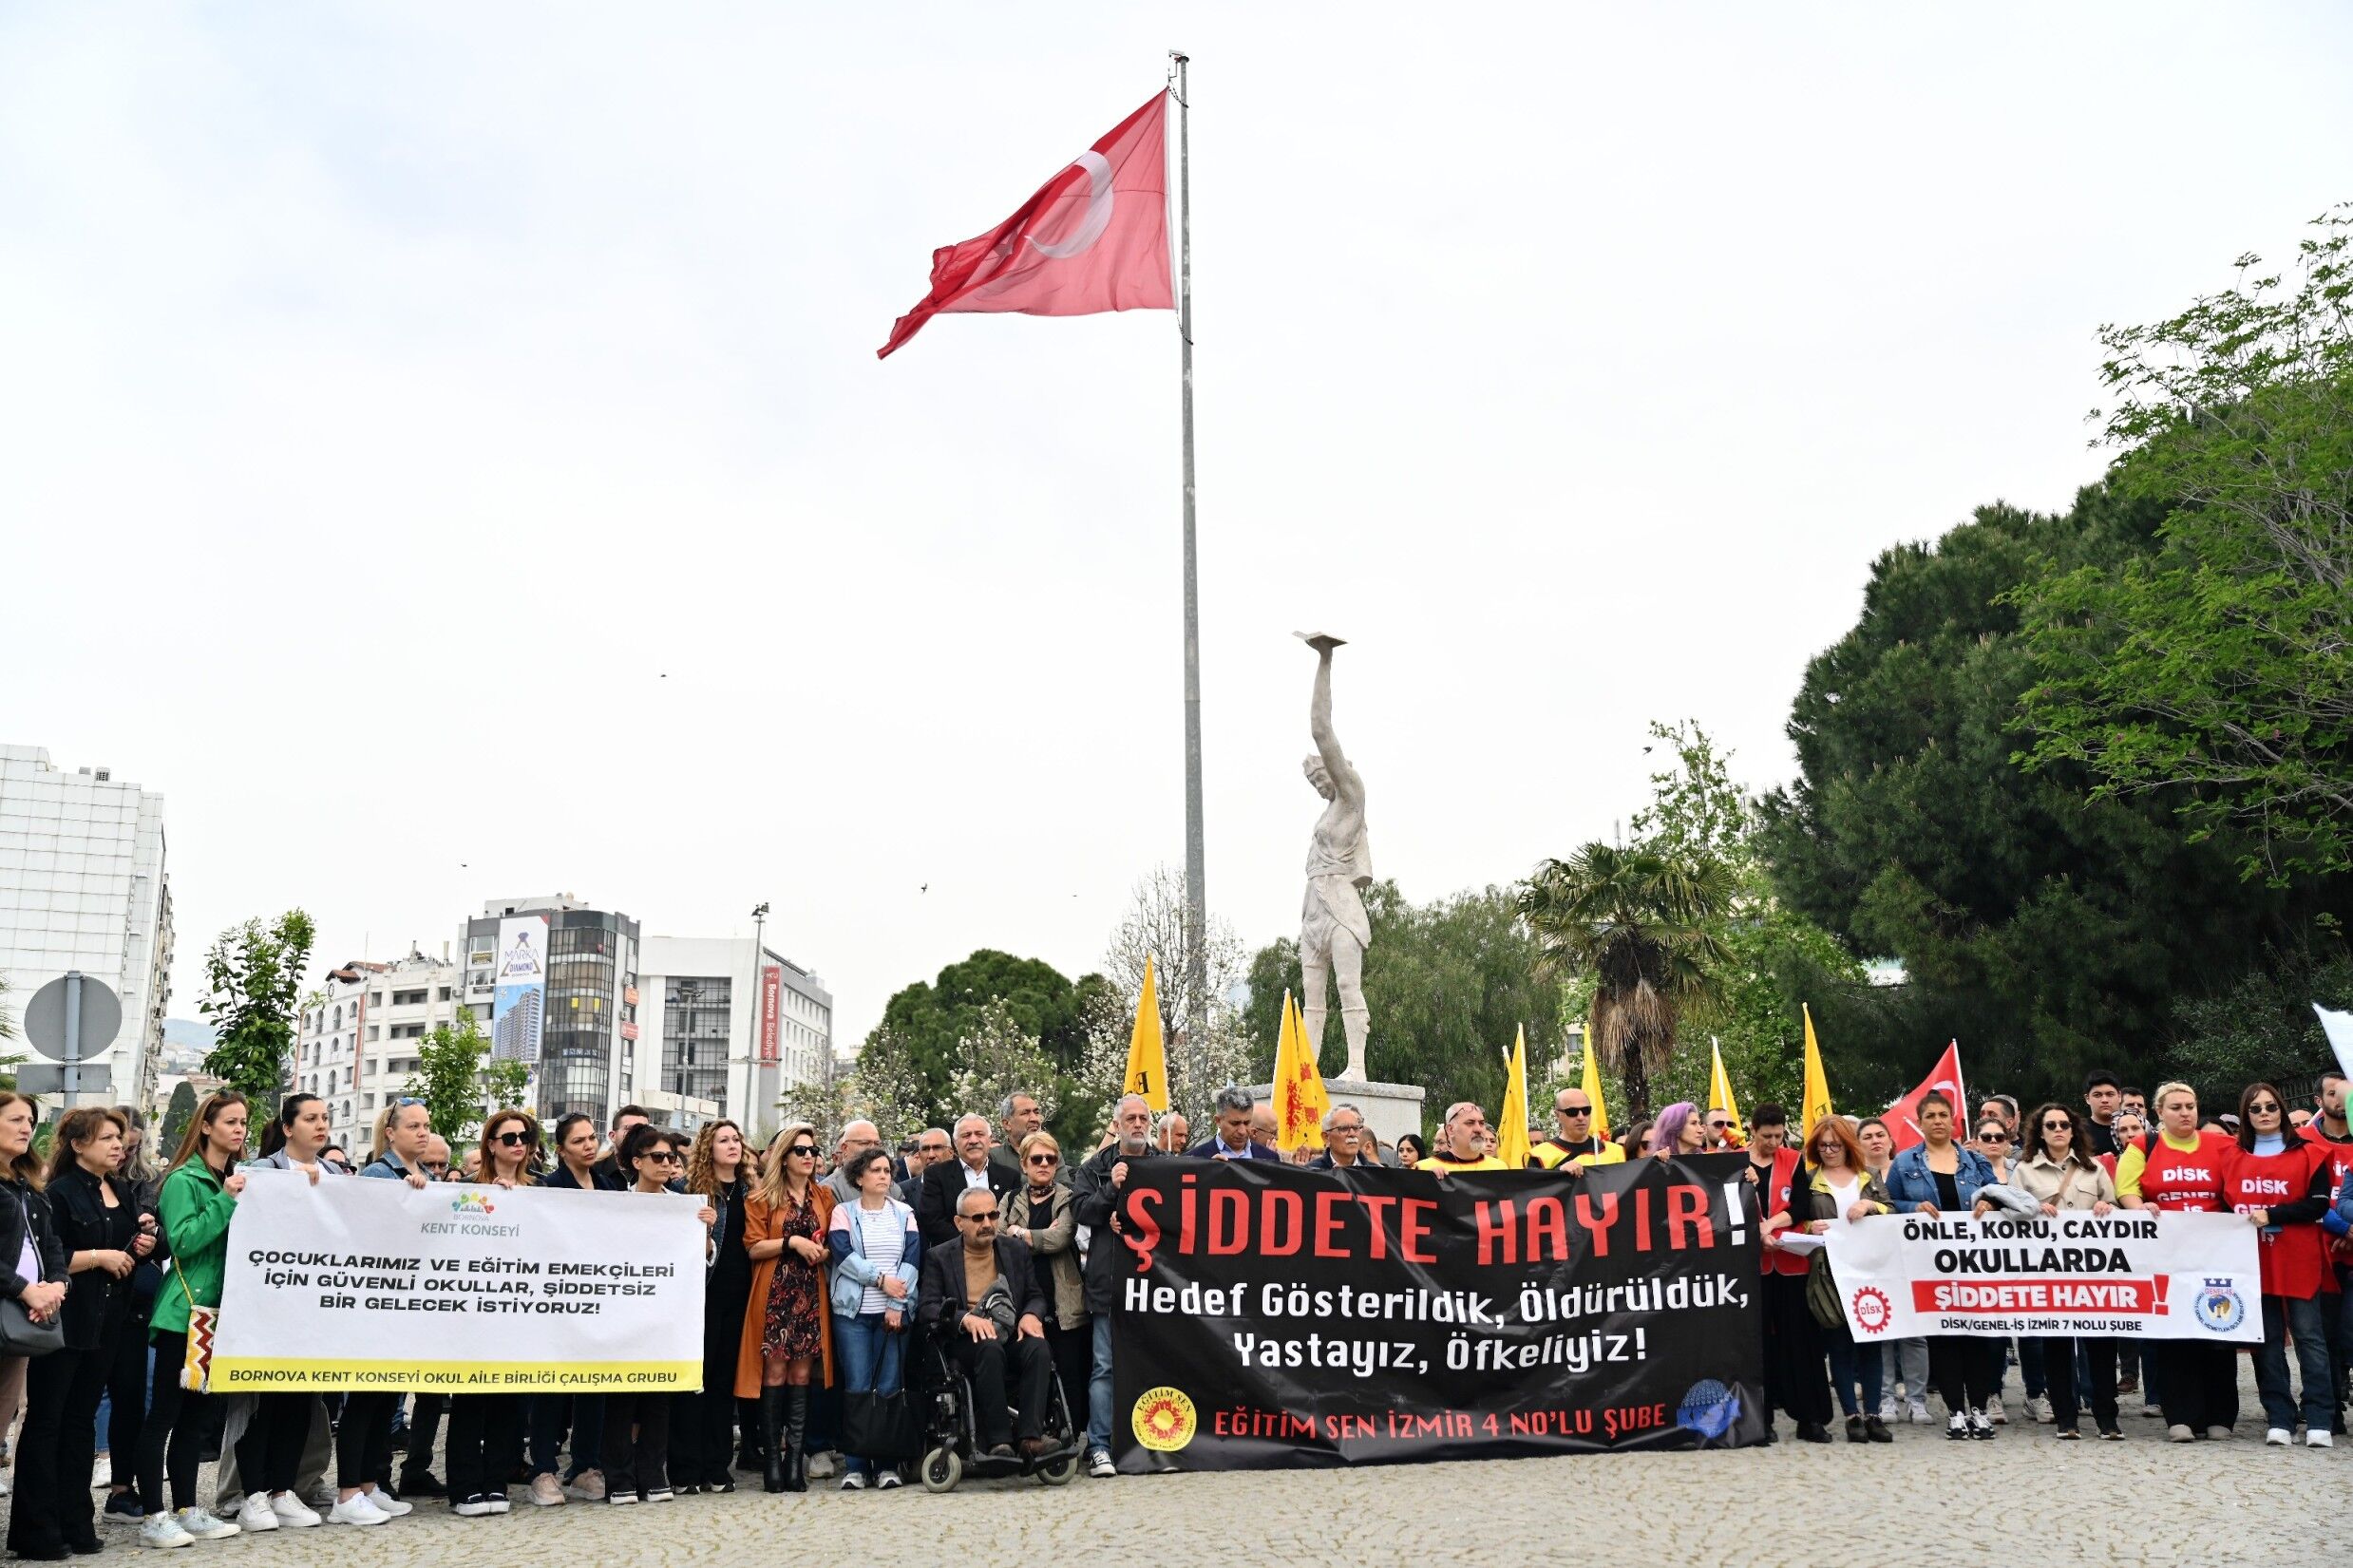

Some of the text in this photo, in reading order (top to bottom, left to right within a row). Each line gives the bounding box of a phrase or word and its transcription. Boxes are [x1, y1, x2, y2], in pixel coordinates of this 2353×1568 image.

[504, 949, 540, 961] MARKA
[765, 983, 776, 1059] Bornova Belediyes
[2162, 1165, 2211, 1182] DİSK
[2241, 1177, 2288, 1195] DİSK
[421, 1222, 520, 1237] KENT KONSEYİ
[1124, 1174, 1745, 1272] ŞİDDETE HAYIR!
[1903, 1219, 2158, 1242] ÖNLE, KORU, CAYDIR
[249, 1250, 674, 1279] ÇOCUKLARIMIZ VE EĞİTİM EMEKÇİLERİ
[1934, 1247, 2132, 1274] OKULLARDA
[264, 1268, 655, 1297] İÇİN GÜVENLİ OKULLAR, ŞİDDETSİZ
[320, 1293, 600, 1313] BİR GELECEK İSTİYORUZ!
[1125, 1274, 1748, 1329] Hedef Gösterildik, Öldürüldük,
[1860, 1302, 1882, 1314] DİSK
[1934, 1282, 2049, 1311] ŞİDDETE
[1941, 1316, 2142, 1332] DİSK/GENEL-İŞ İZMİR 7 NOLU ŞUBE
[1234, 1327, 1646, 1377] Yastayız, Öfkeliyiz!
[230, 1370, 677, 1386] BORNOVA KENT KONSEYİ OKUL AİLE BİRLİĞİ ÇALIŞMA GRUBU
[1177, 1394, 1192, 1412] SEN
[1215, 1406, 1316, 1439] EĞİTİM
[1325, 1414, 1376, 1440] SEN
[1388, 1409, 1472, 1438] İZMİR
[1482, 1413, 1499, 1437] 4
[1603, 1404, 1666, 1440] ŞUBE
